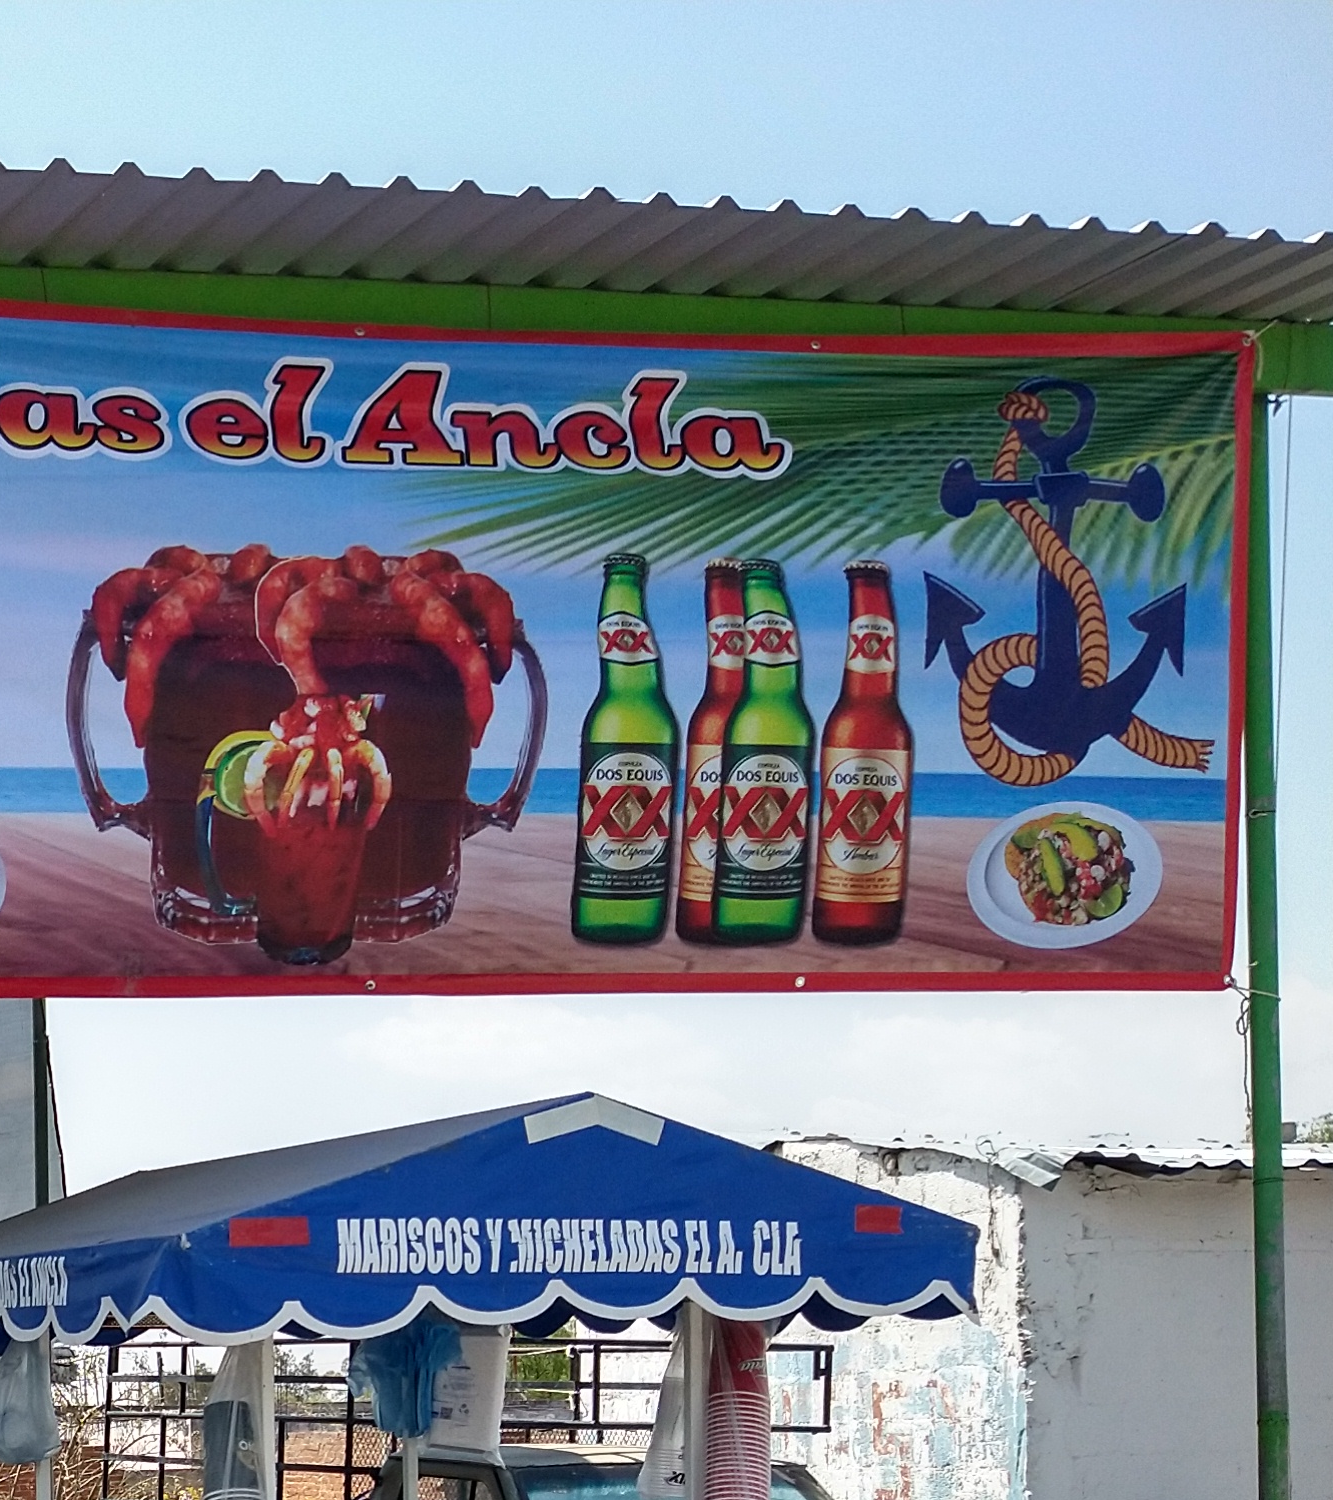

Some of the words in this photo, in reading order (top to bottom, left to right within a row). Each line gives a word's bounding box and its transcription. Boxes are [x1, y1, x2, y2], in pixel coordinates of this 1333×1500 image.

[187, 362, 331, 464] el
[341, 368, 785, 473] Ancla
[596, 769, 622, 781] DOS
[626, 769, 664, 781] EQUIS
[736, 770, 762, 783] DOS
[765, 771, 799, 783] EQUIS
[834, 773, 860, 785] DOS
[863, 774, 898, 787] EQUIS
[582, 784, 672, 840] XX
[687, 786, 721, 839] X
[722, 785, 808, 840] XX
[822, 788, 906, 843] XX
[336, 1217, 481, 1275] MARISCOS
[485, 1218, 503, 1273] Y
[508, 1218, 681, 1274] MICHELADAS
[684, 1219, 712, 1274] EL
[716, 1220, 803, 1276] ACLA
